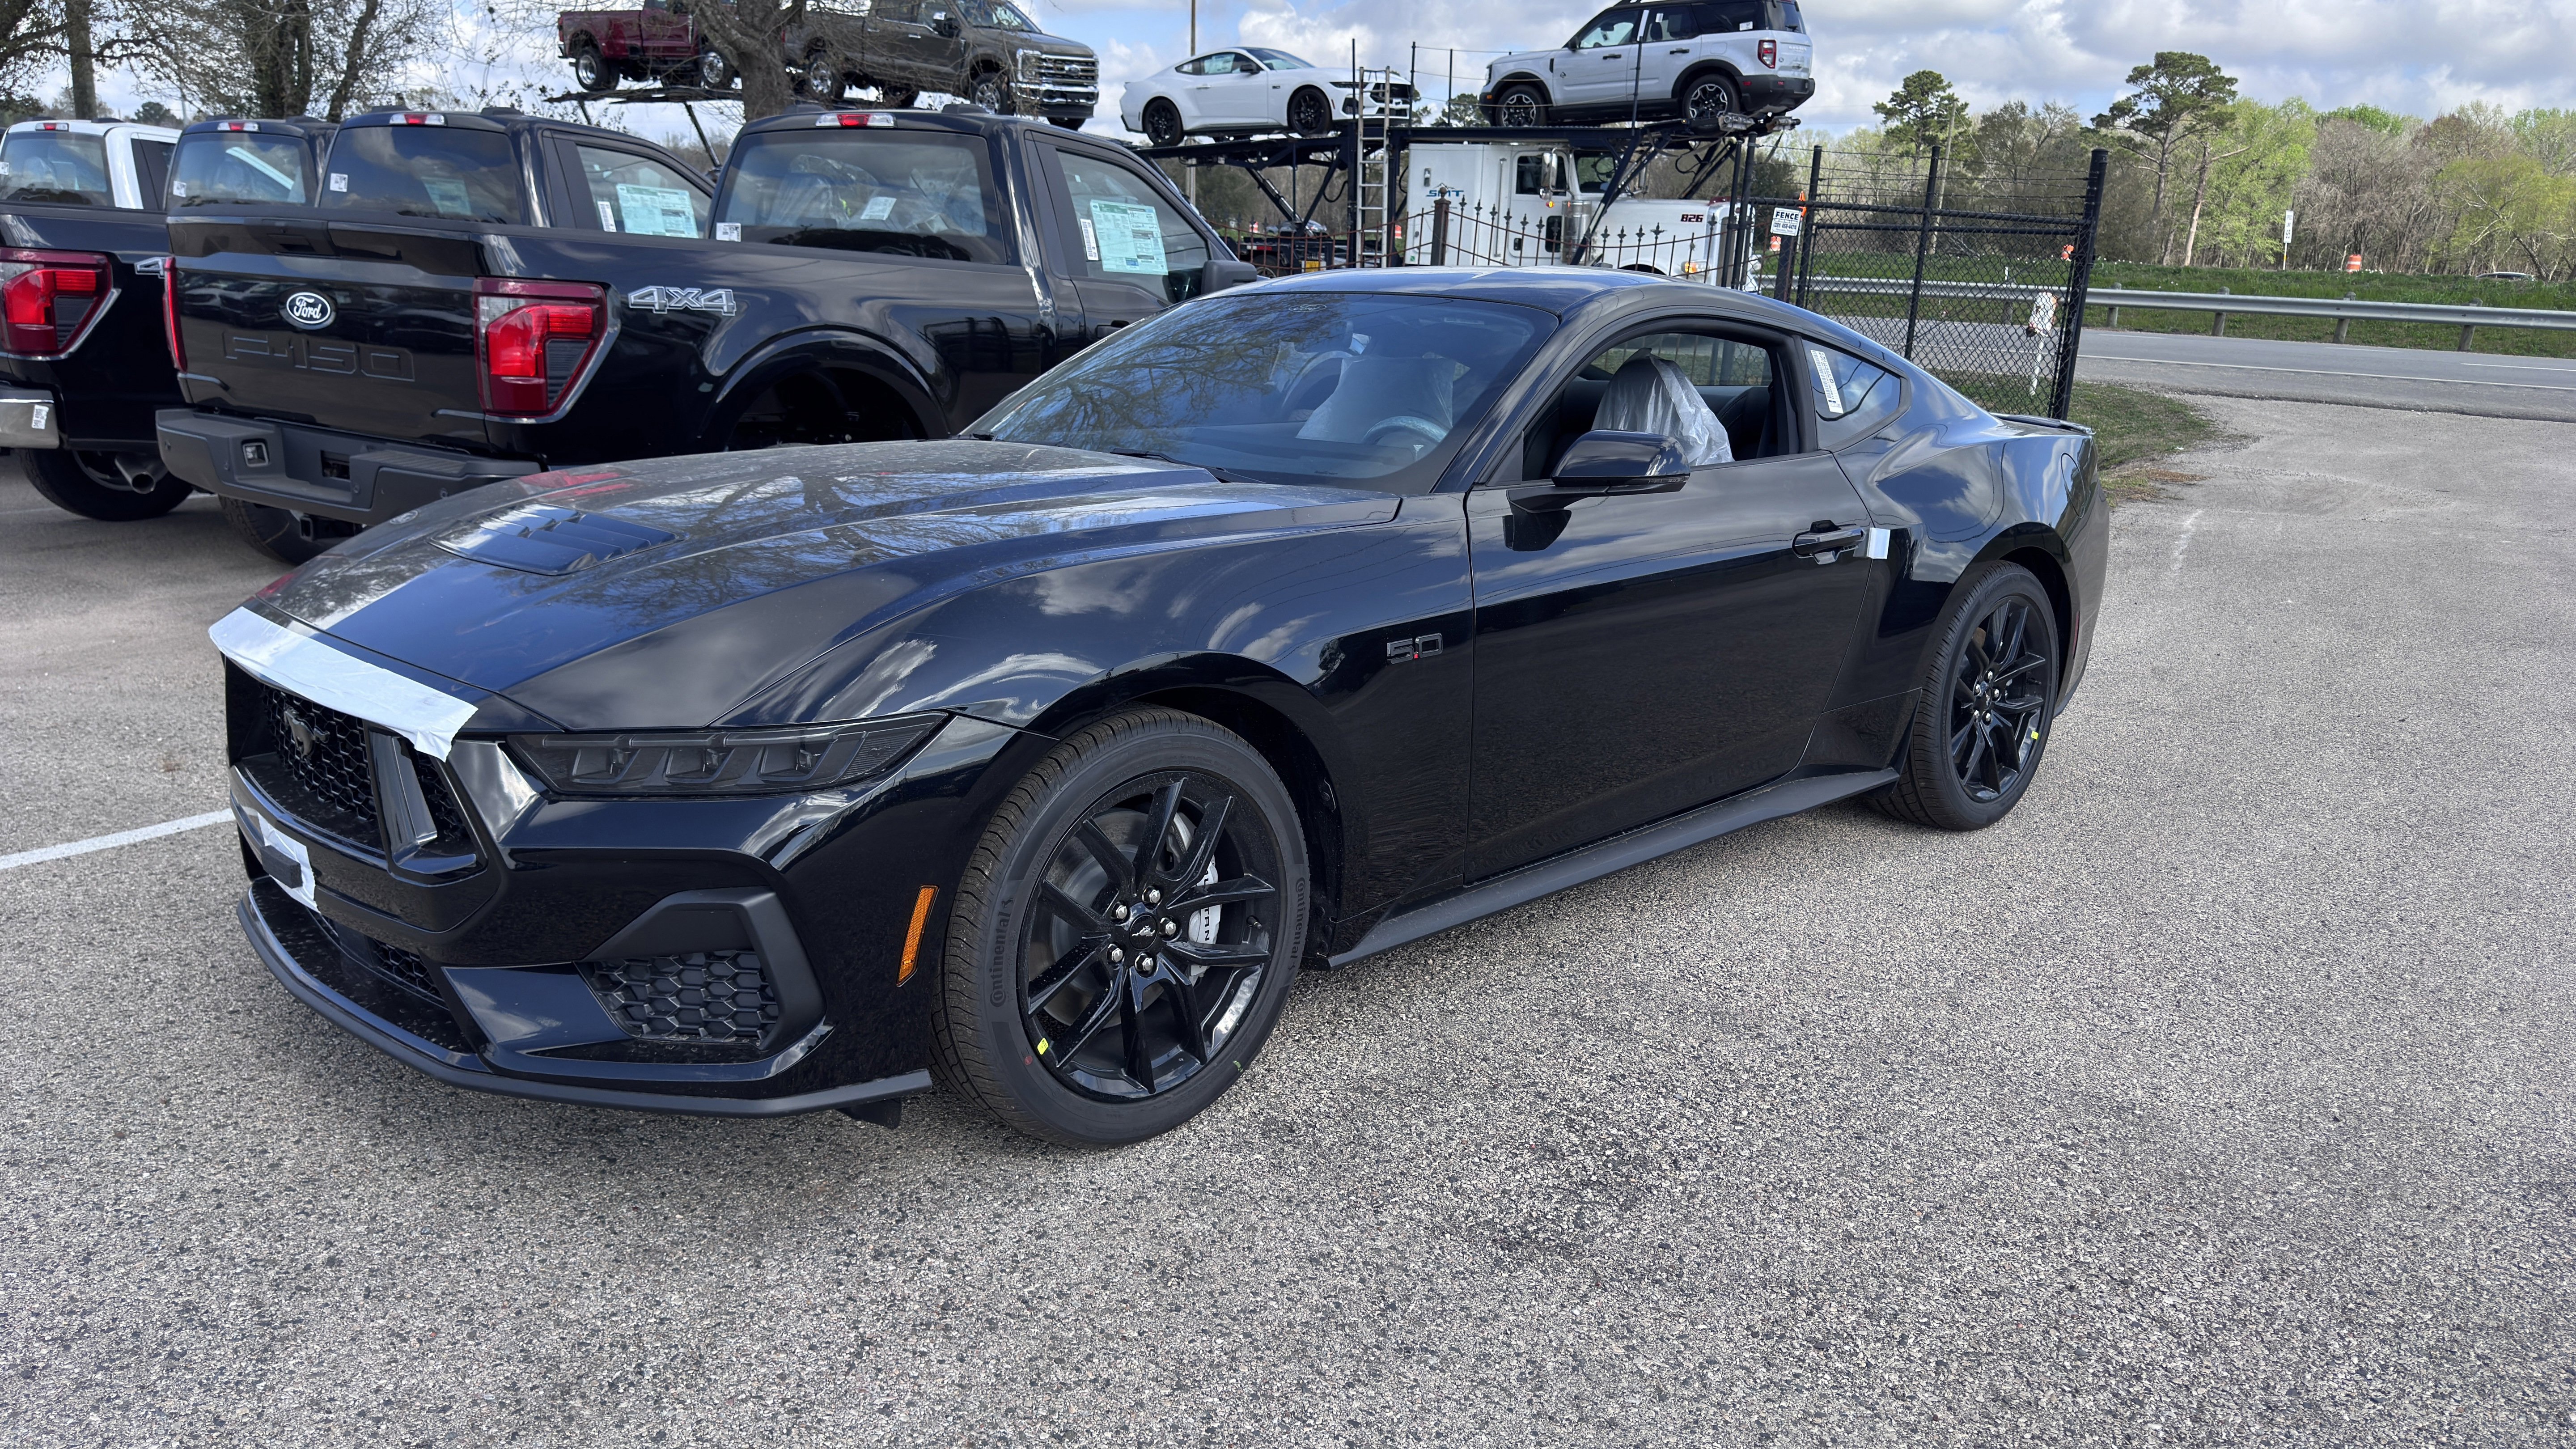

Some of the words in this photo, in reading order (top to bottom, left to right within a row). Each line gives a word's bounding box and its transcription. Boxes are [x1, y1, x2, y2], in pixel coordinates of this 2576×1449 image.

[1681, 214, 1703, 222] 826
[1775, 211, 1799, 220] FENCE
[293, 296, 322, 319] Ford
[1386, 632, 1443, 664] 5.0
[1290, 877, 1306, 958] Continental
[989, 911, 1012, 1007] Continental
